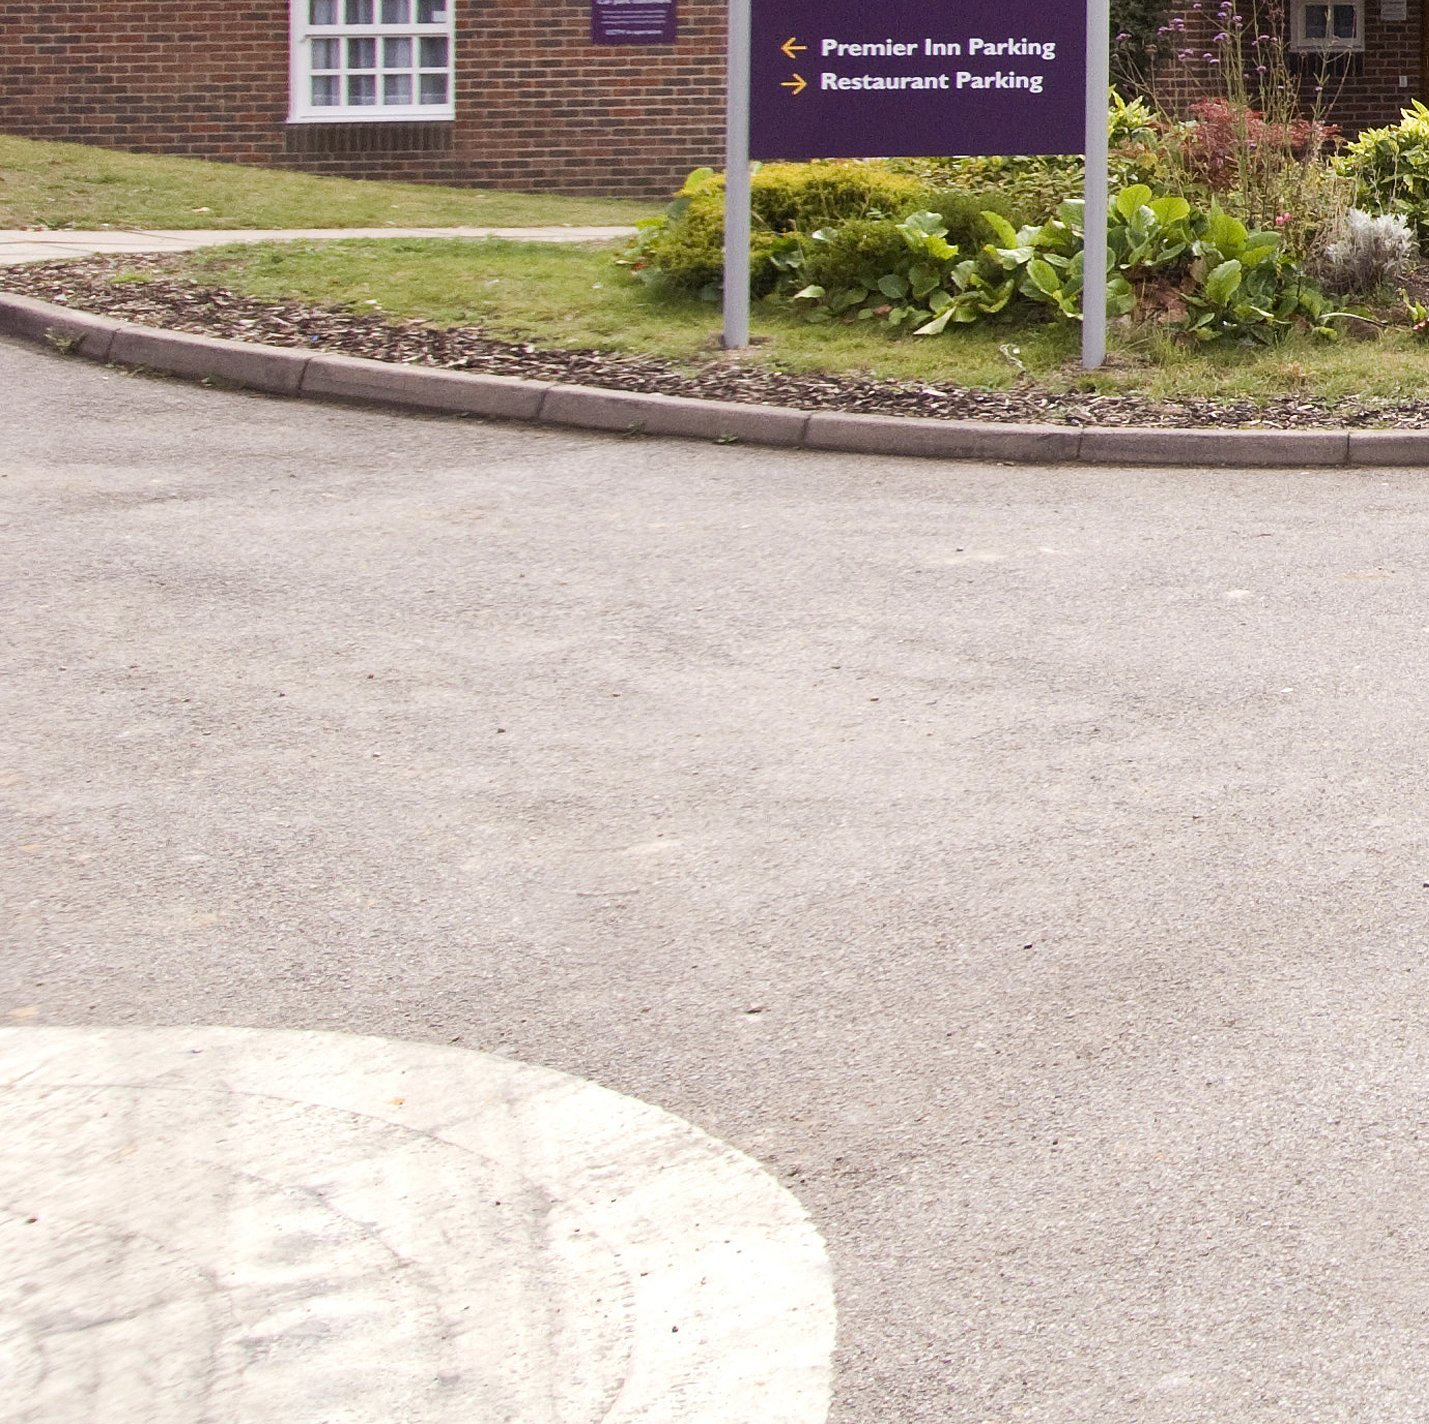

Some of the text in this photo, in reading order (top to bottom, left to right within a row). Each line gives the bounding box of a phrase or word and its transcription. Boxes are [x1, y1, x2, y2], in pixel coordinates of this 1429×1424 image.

[820, 37, 1056, 60] Premier Inn Parking
[820, 71, 1044, 93] Restaurant Parking
